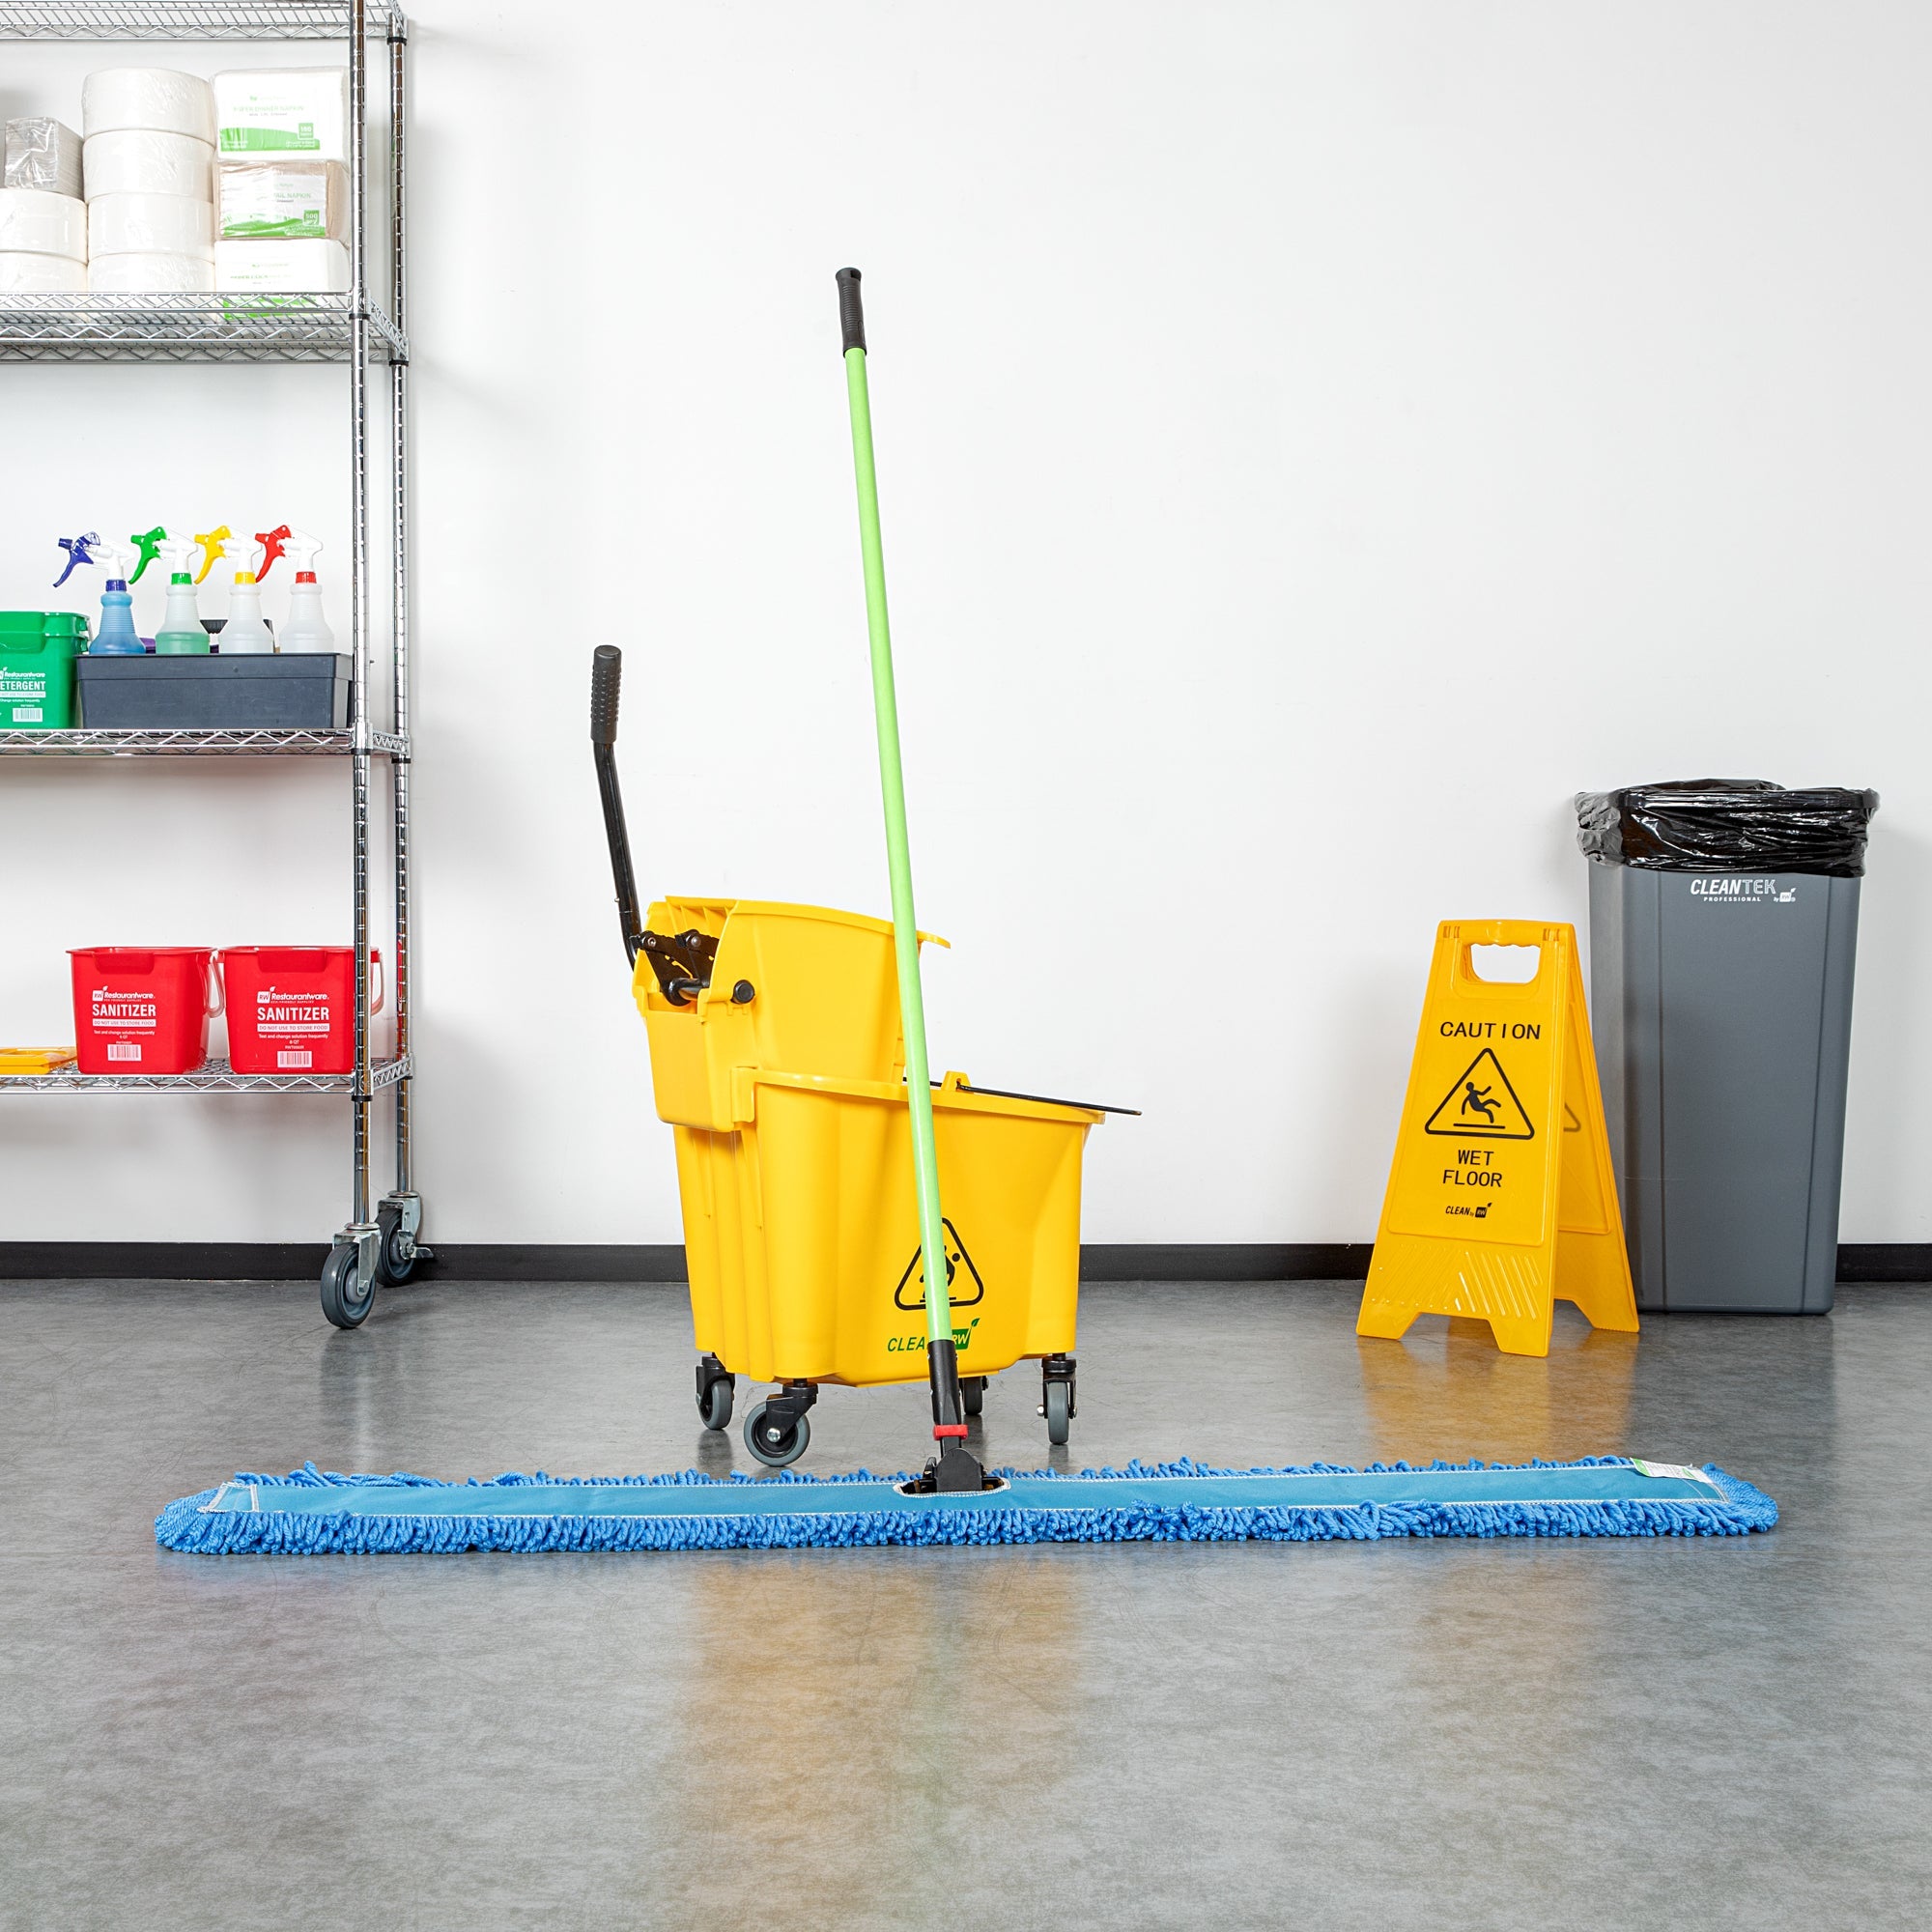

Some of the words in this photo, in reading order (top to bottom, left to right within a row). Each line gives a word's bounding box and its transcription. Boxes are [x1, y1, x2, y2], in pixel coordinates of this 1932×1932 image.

[0, 680, 46, 691] ETERGENT
[1690, 879, 1776, 895] CLEANTEK
[92, 1004, 156, 1017] SANITIZER
[257, 1007, 329, 1021] SANITIZER
[1440, 1021, 1541, 1039] CAUTION
[1458, 1150, 1494, 1166] WET
[1443, 1169, 1502, 1188] FLOOR
[1445, 1206, 1470, 1215] CLEAN
[887, 1336, 928, 1352] CLEA
